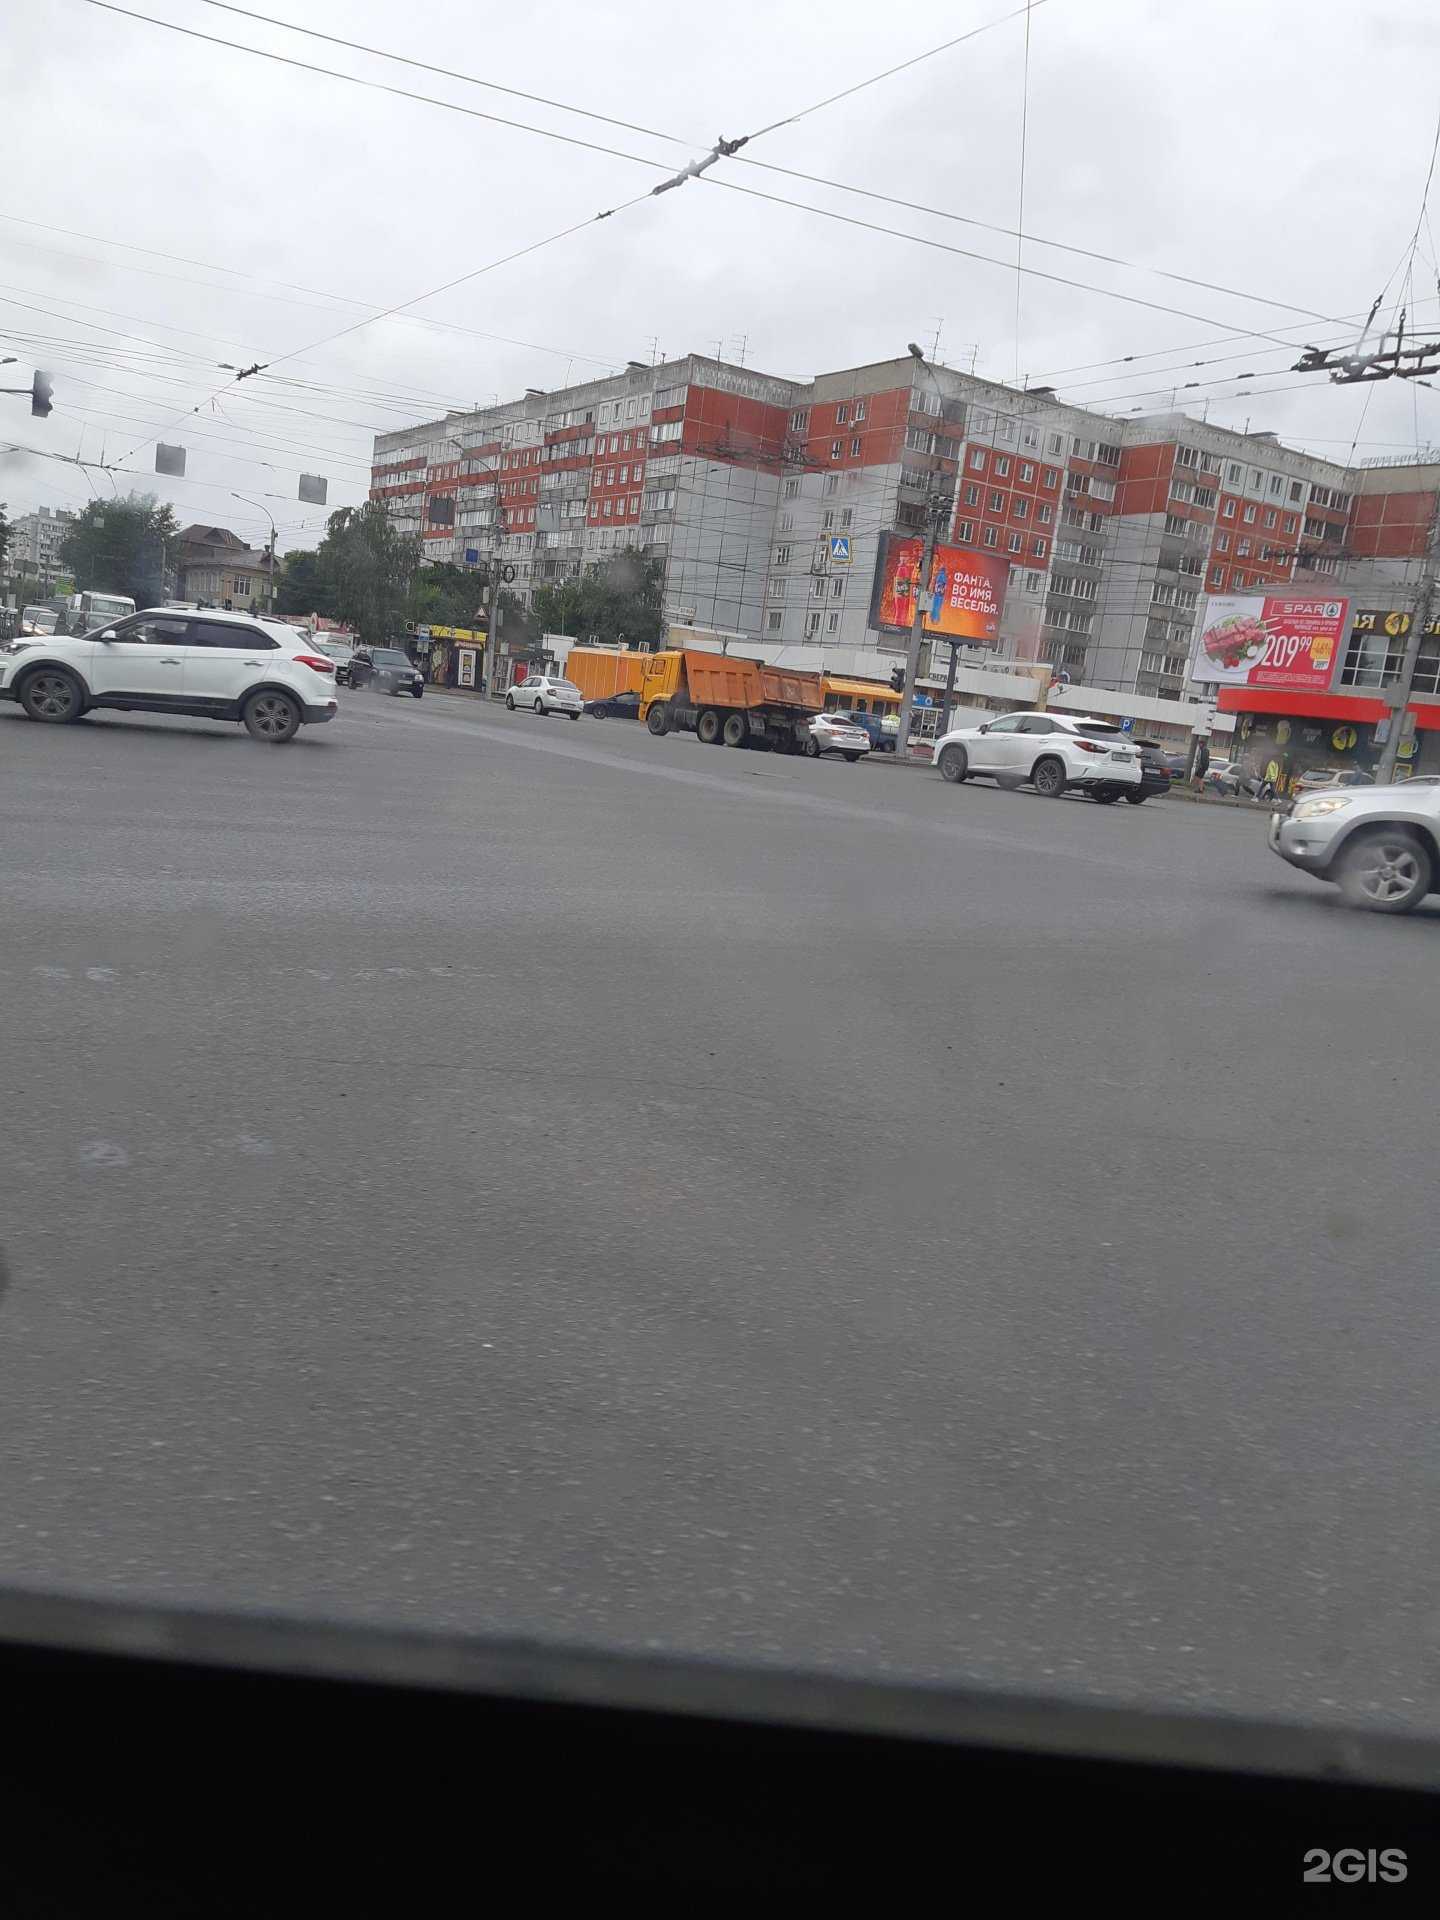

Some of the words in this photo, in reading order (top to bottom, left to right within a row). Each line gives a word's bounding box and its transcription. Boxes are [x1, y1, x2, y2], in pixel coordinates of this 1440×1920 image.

[953, 572, 993, 590] ФАНТА.
[952, 584, 969, 598] ВО
[969, 585, 993, 601] ИМЯ
[950, 597, 999, 615] ВЕСЕЛЬЯ.
[1283, 603, 1324, 615] SPAR
